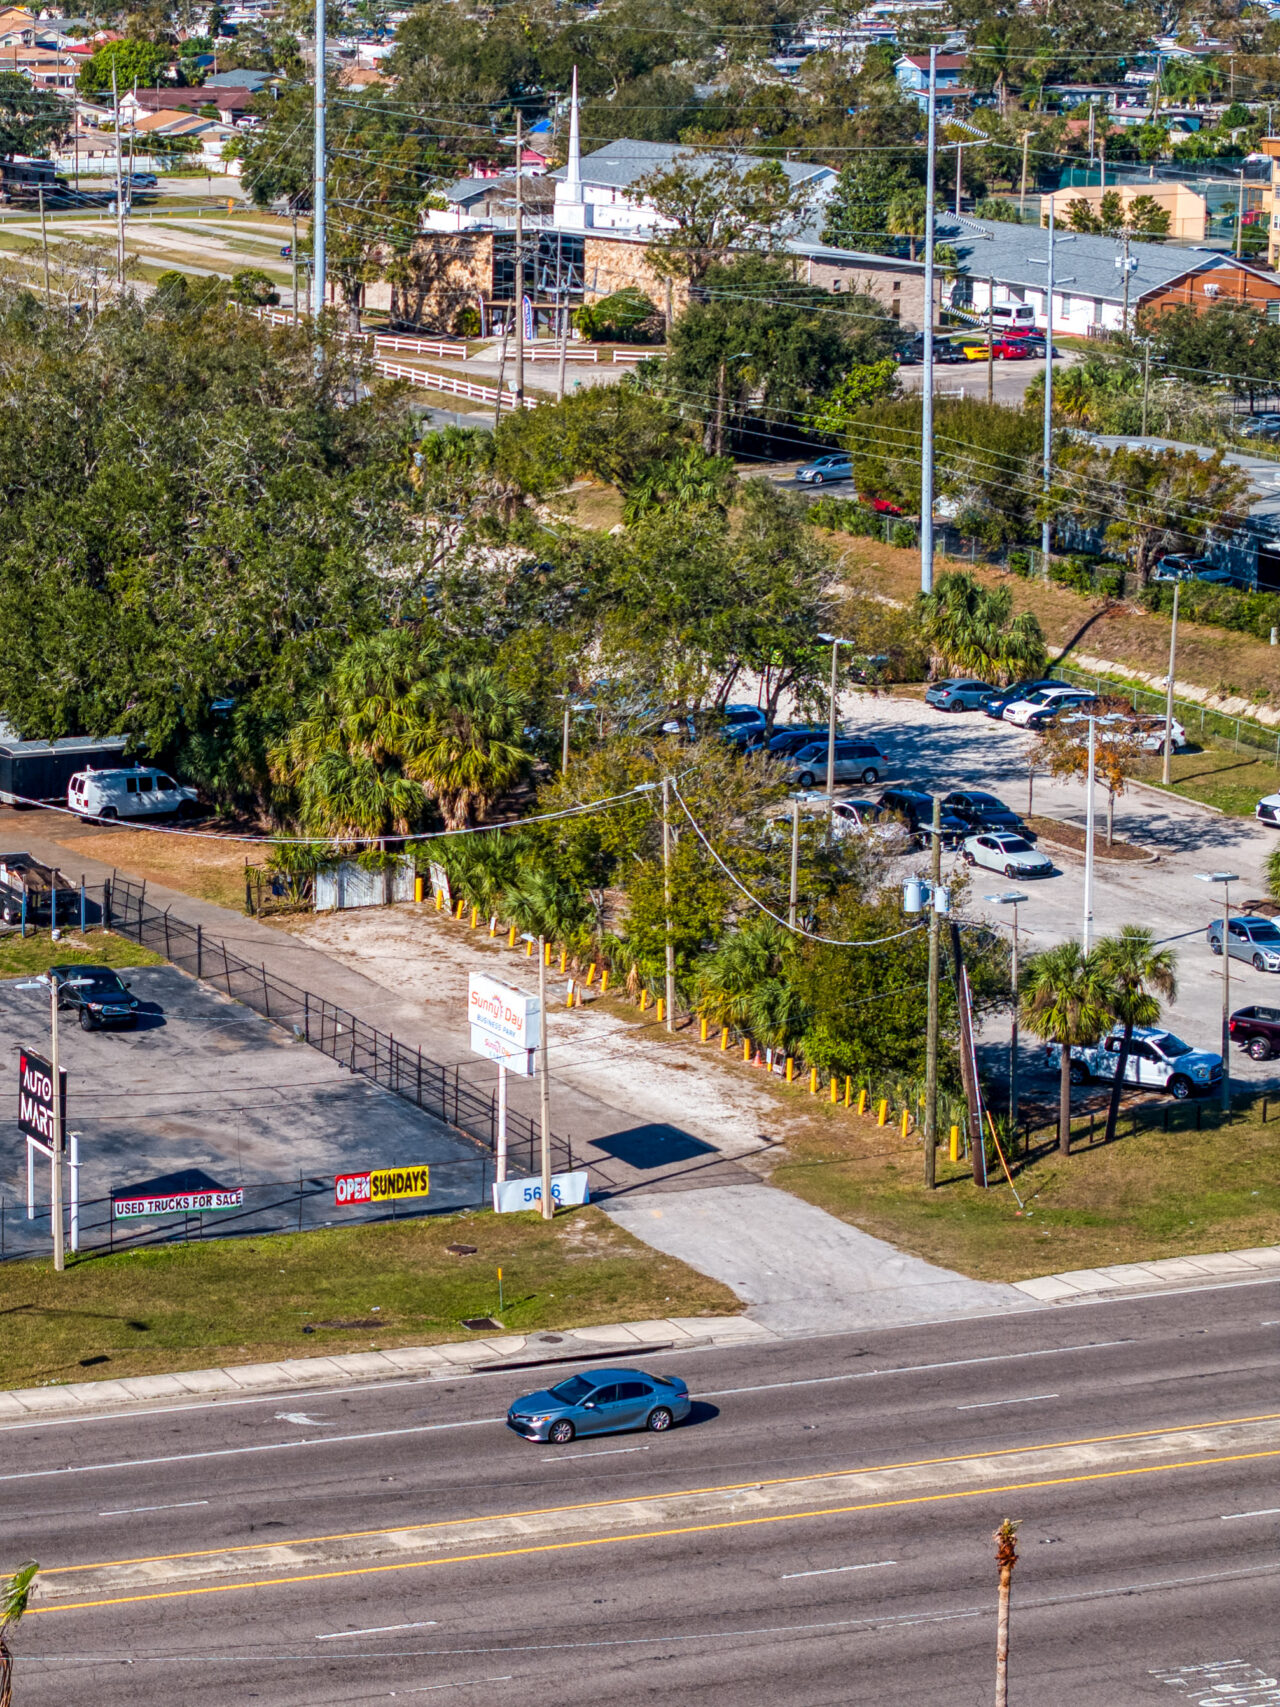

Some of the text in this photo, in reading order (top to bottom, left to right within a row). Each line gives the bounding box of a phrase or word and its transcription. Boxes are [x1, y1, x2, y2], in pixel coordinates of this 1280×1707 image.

[470, 991, 523, 1031] Sunny Day
[476, 1013, 516, 1037] BUSINESS PARK
[23, 1065, 52, 1101] AUTO
[21, 1091, 55, 1138] MART
[336, 1170, 427, 1201] OPEN SUNDAYS
[523, 1184, 561, 1202] 566
[116, 1191, 242, 1215] USED TRUCKS FOR SALE
